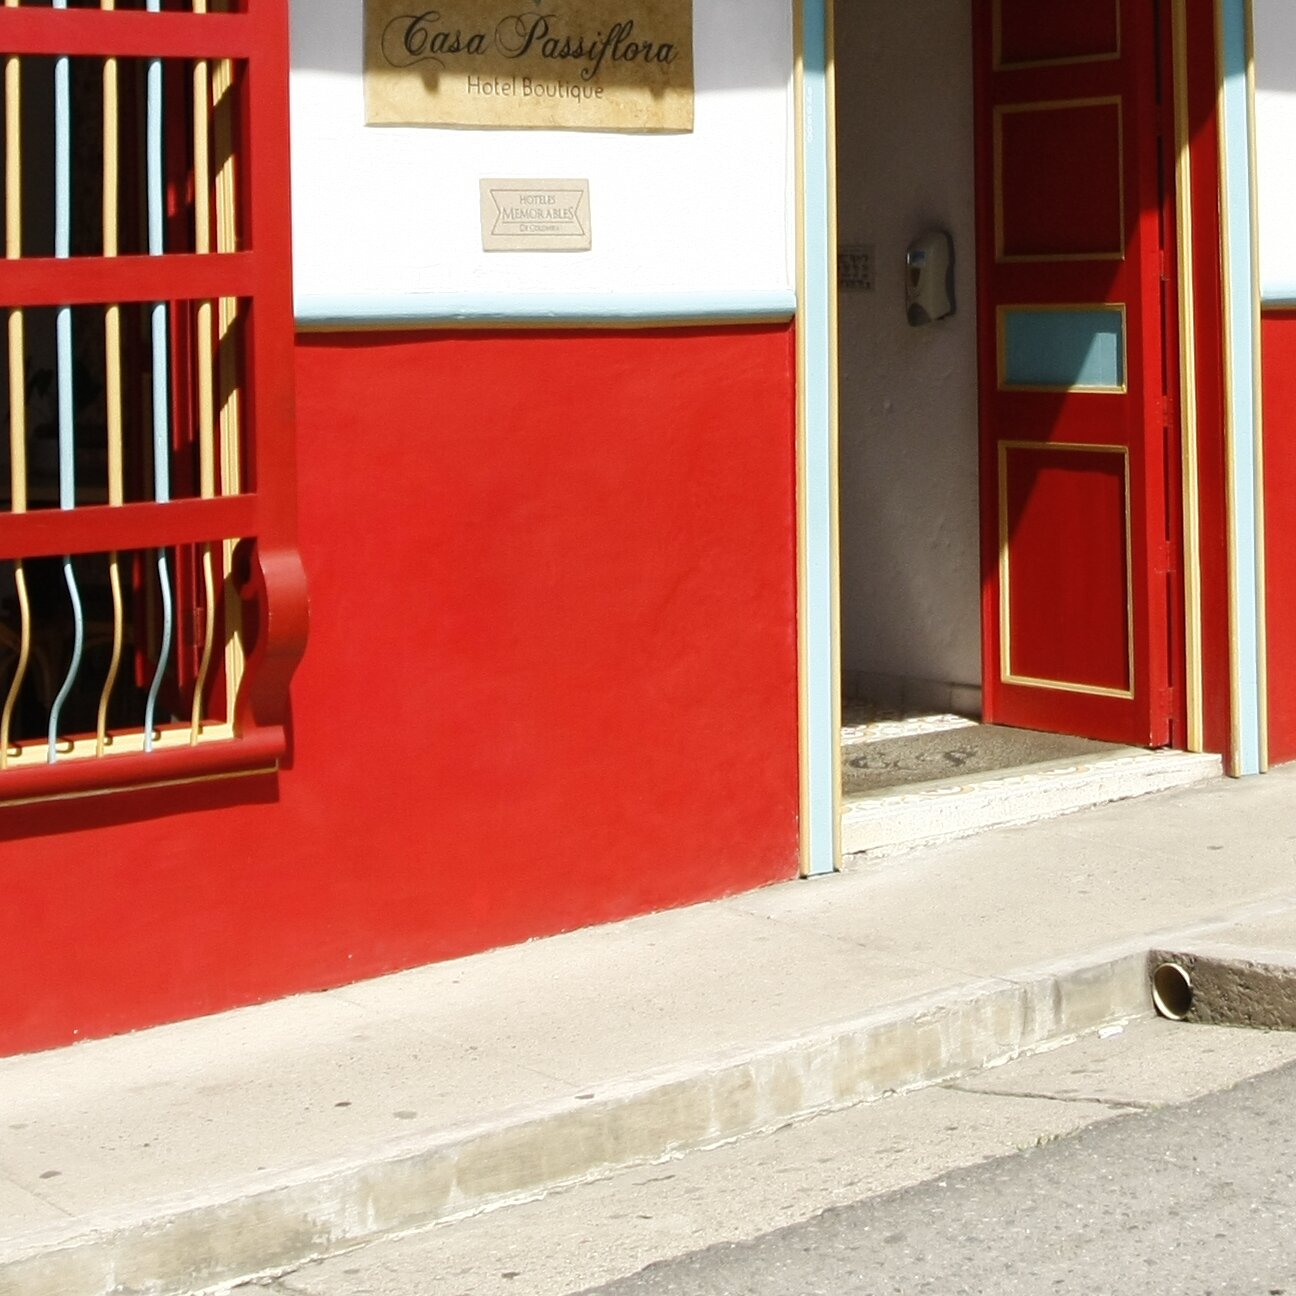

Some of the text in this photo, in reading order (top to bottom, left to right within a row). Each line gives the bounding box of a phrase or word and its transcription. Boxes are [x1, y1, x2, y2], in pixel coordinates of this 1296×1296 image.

[381, 10, 680, 82] Casa Passiflora
[466, 75, 605, 104] Hotel Boutique
[519, 194, 556, 205] HOTELES
[502, 207, 574, 220] MEMORABLES
